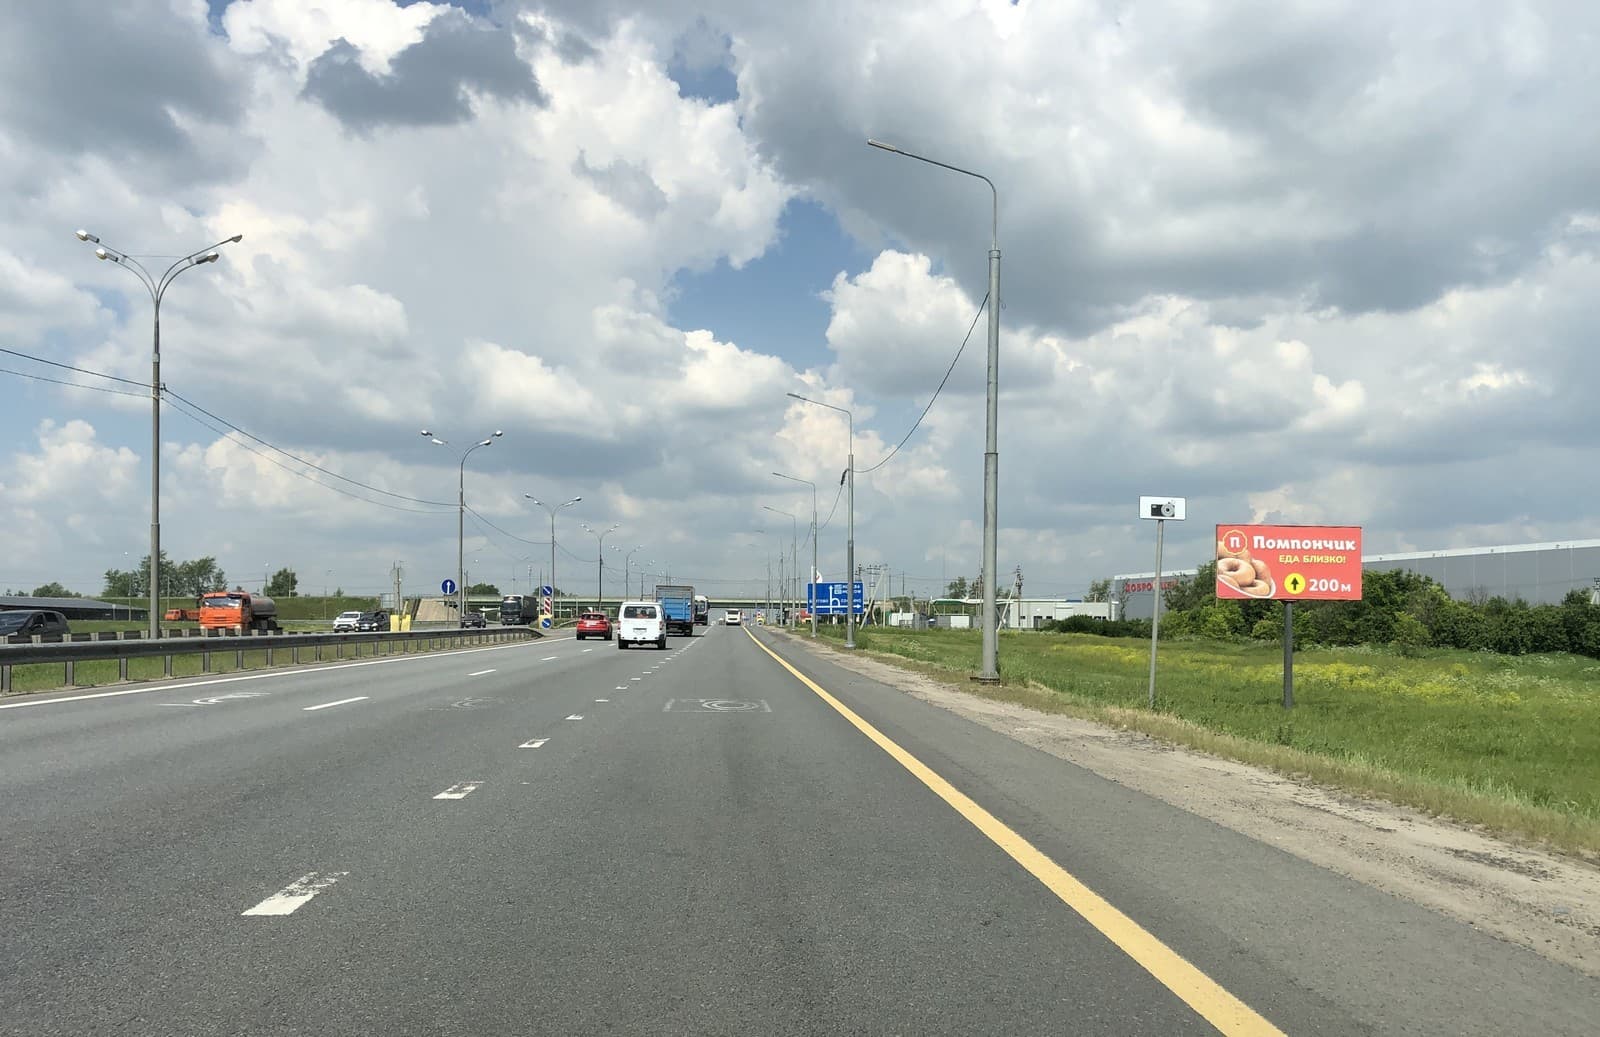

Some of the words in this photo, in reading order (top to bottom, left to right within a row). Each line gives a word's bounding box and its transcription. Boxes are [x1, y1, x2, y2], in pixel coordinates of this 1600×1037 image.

[1229, 537, 1241, 548] П
[1253, 535, 1356, 551] Помпончик
[1279, 555, 1300, 565] ЕДА
[1303, 555, 1346, 564] БЛИЗКО!
[1309, 578, 1339, 592] 200
